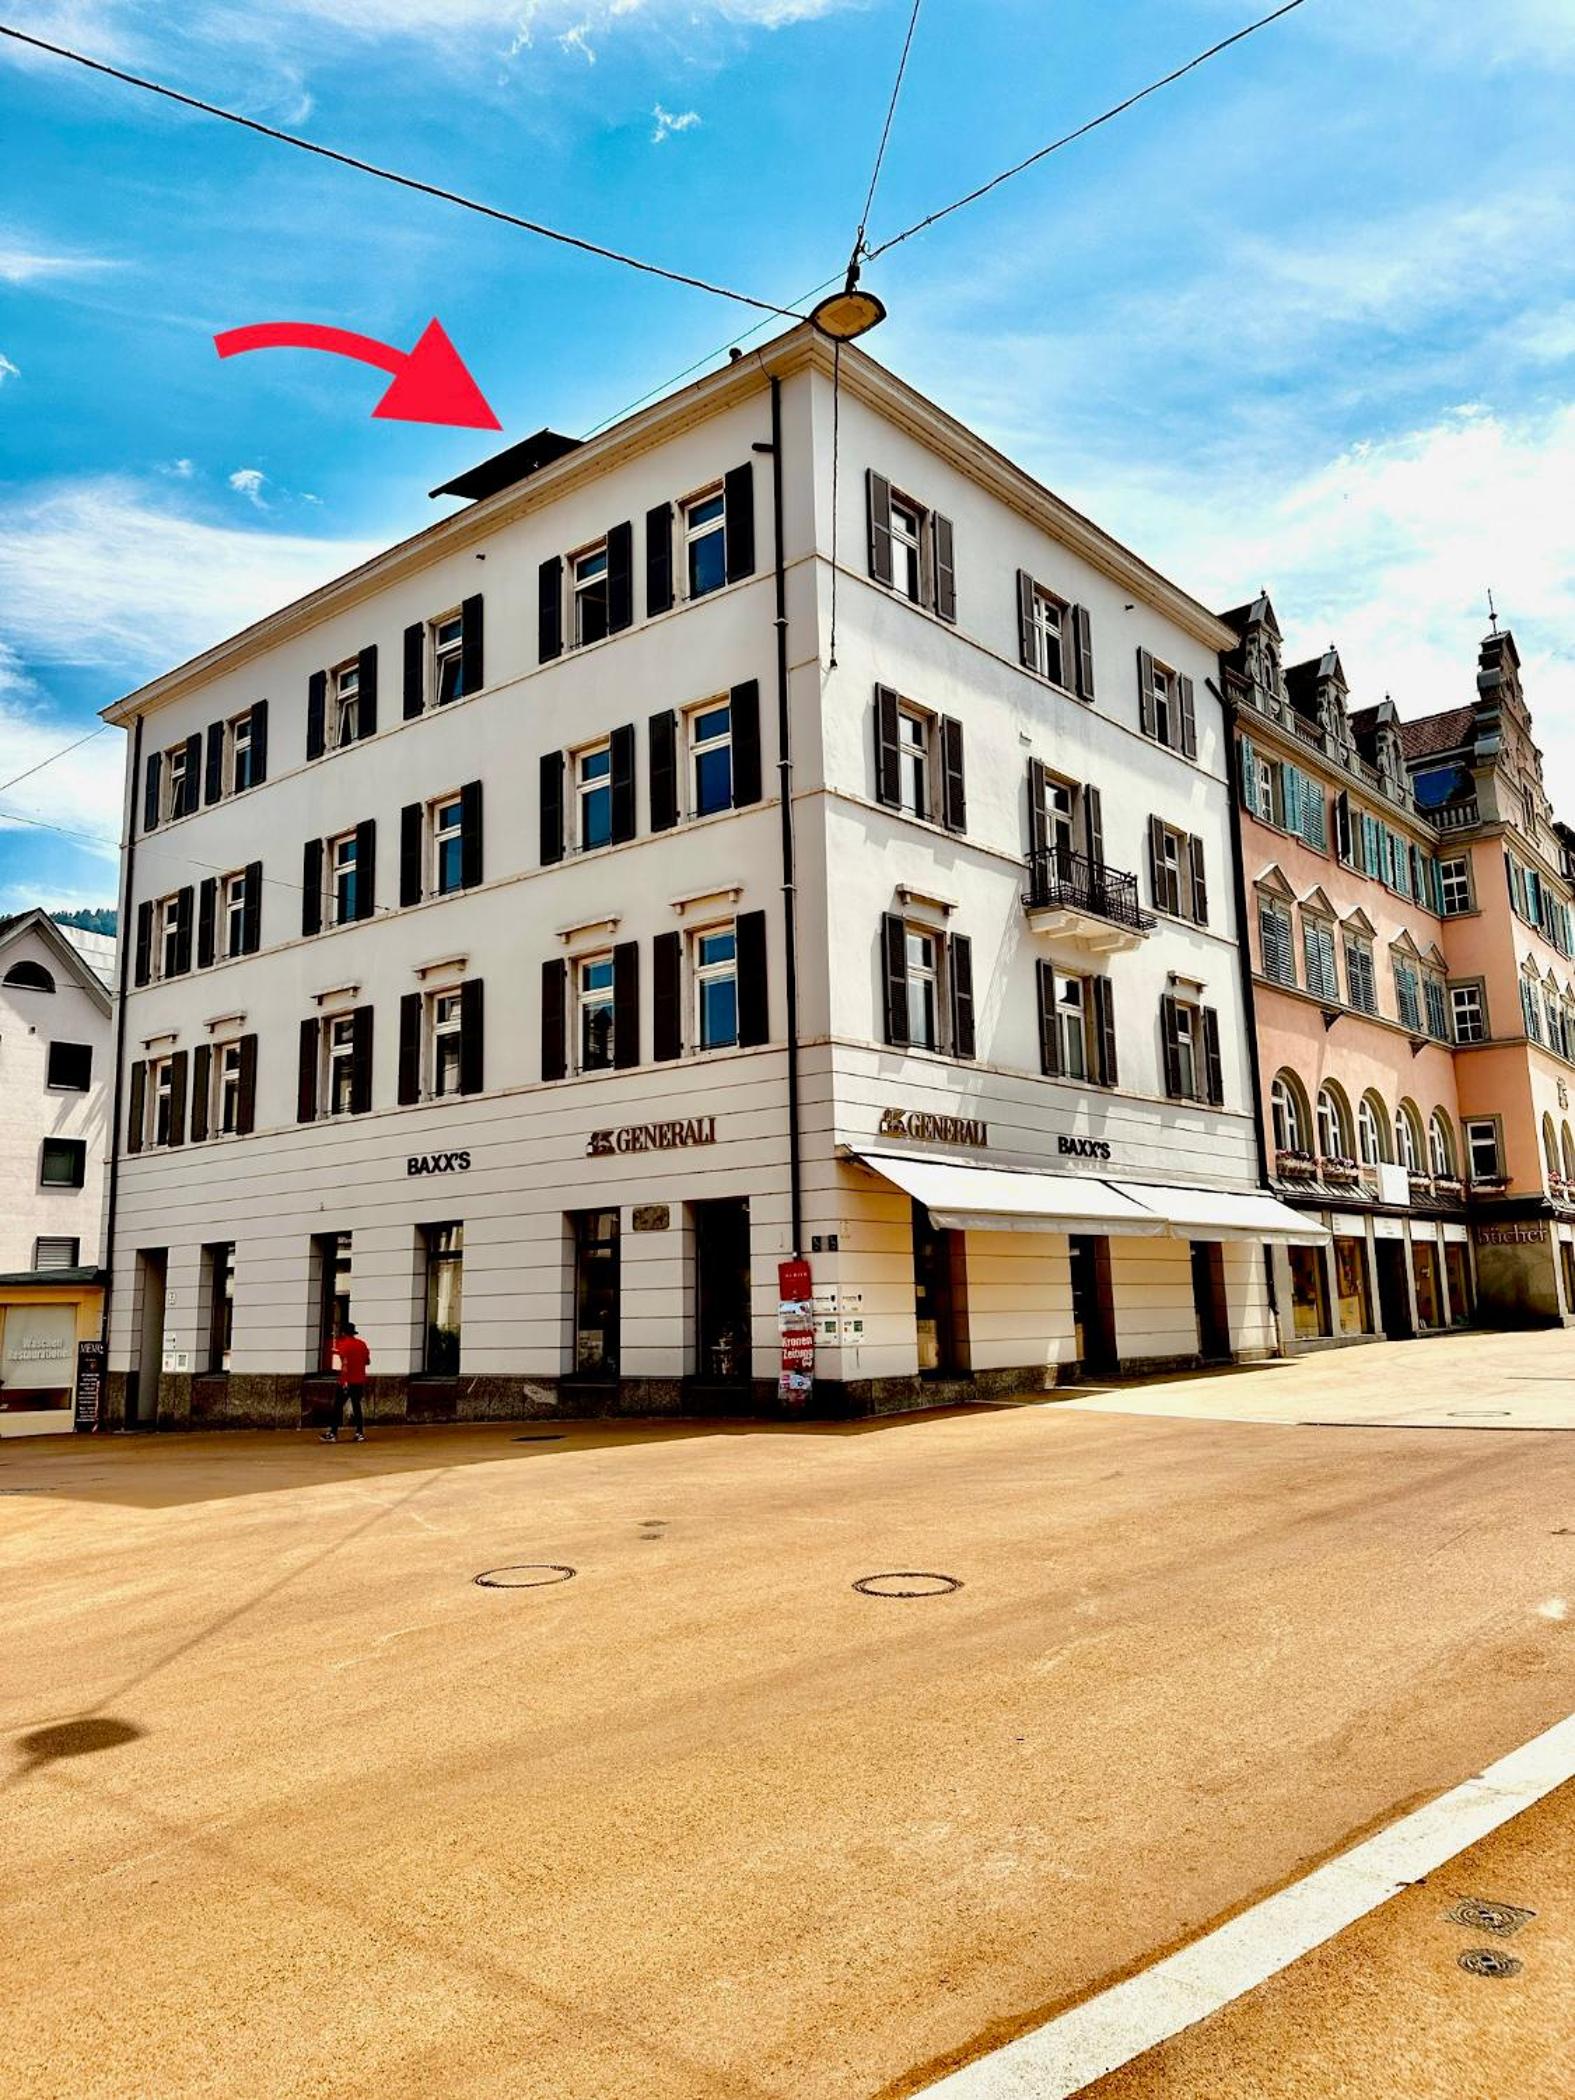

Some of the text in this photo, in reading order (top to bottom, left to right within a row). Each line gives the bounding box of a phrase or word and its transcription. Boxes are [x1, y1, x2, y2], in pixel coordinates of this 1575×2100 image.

[615, 1117, 717, 1153] GENERALI
[907, 1111, 989, 1147] GENERALI
[1057, 1136, 1111, 1160] BAXX'S
[407, 1151, 471, 1176] BAXX'S
[782, 1336, 813, 1348] Kronen
[783, 1348, 814, 1360] Zeitung
